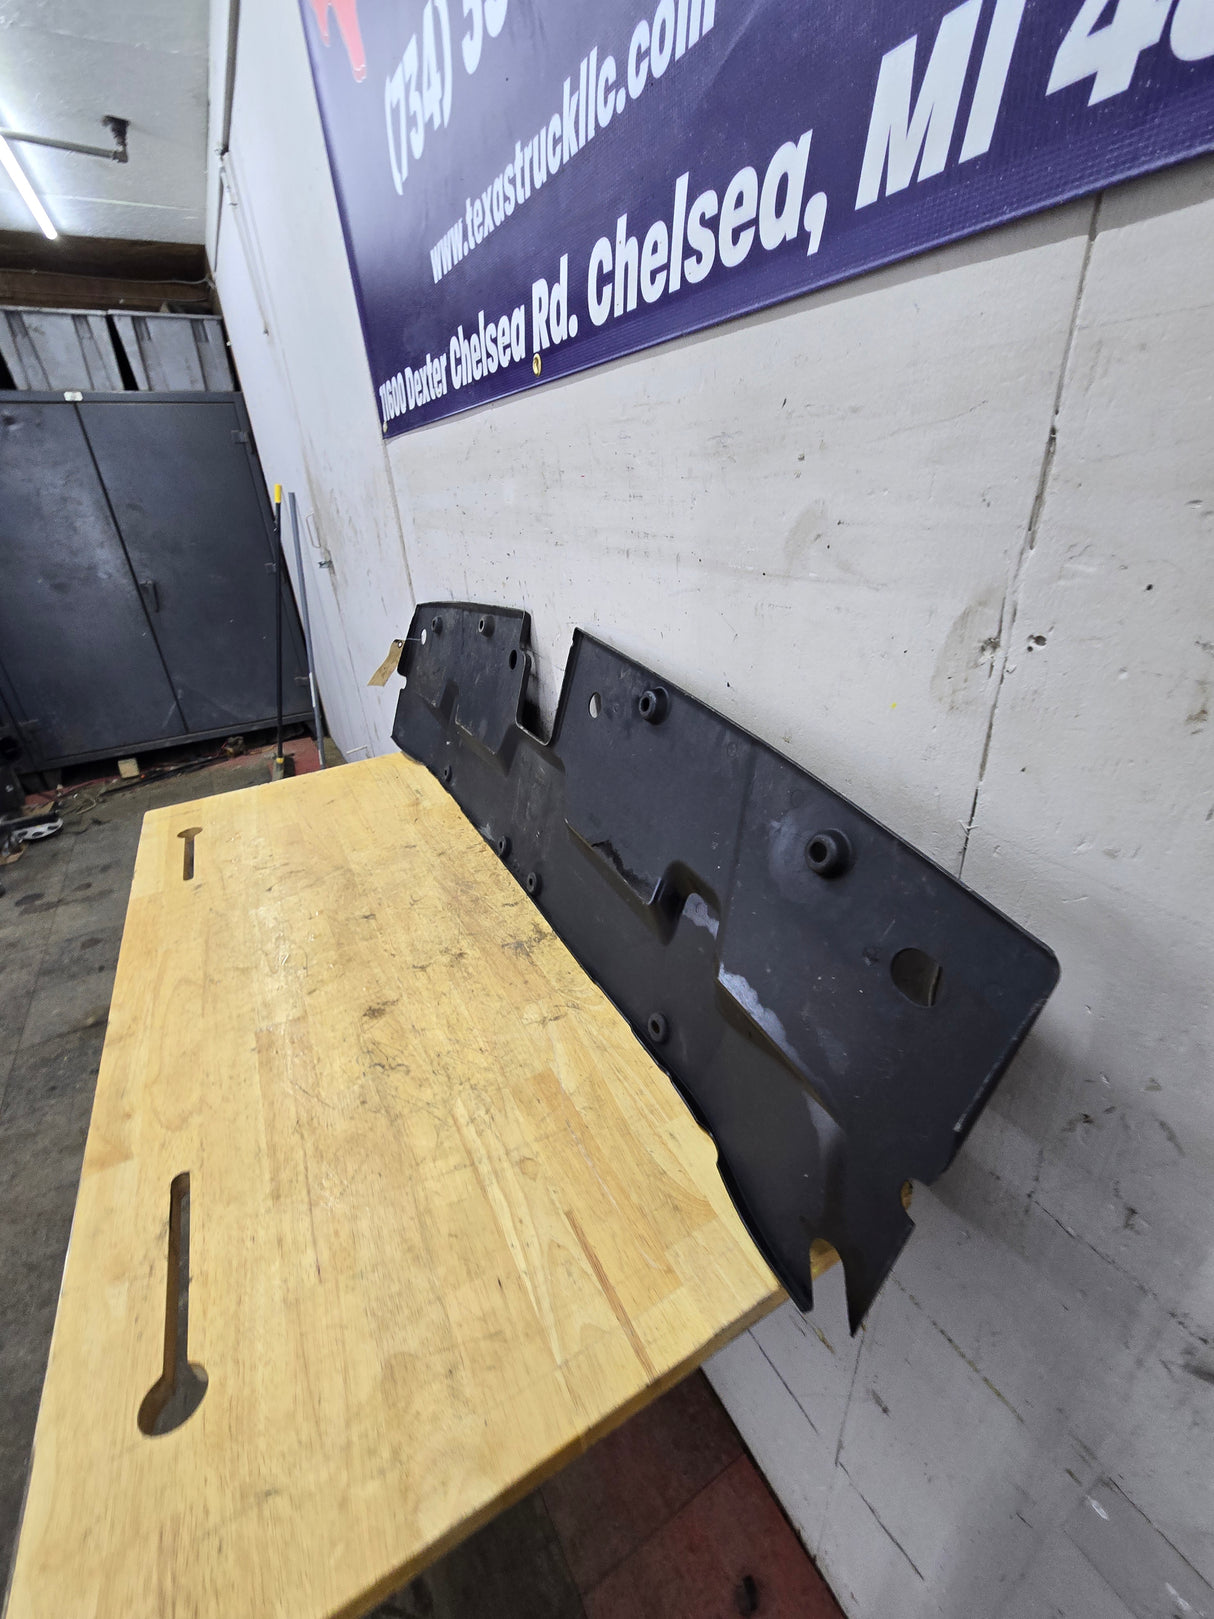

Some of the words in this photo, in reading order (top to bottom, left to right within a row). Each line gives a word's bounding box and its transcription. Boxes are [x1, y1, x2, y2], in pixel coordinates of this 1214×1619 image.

[385, 0, 453, 195] (734)
[404, 352, 447, 411] Dexter
[449, 305, 525, 390] Chelsea
[532, 253, 579, 353] Rd.
[587, 128, 828, 326] Chelsea,
[854, 0, 1026, 211] MI
